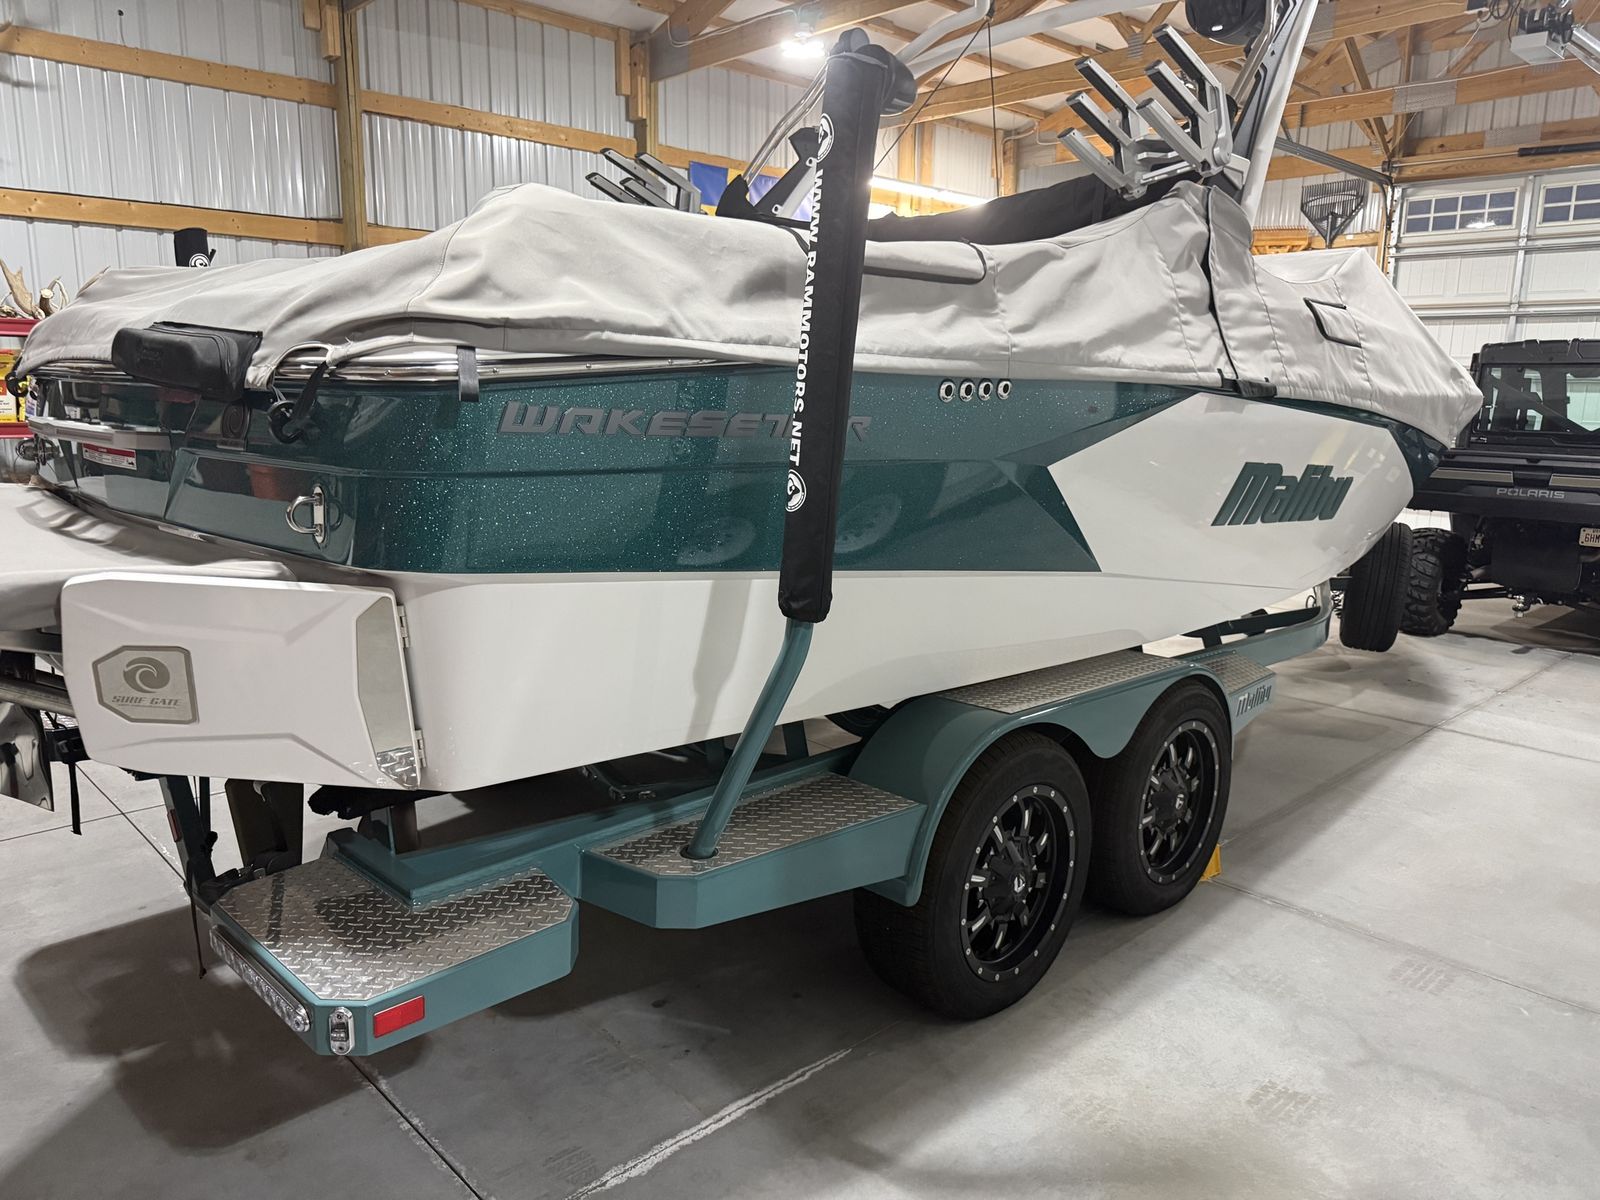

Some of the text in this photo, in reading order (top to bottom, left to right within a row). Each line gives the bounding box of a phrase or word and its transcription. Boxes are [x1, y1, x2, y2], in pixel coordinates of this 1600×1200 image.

[497, 400, 873, 441] WAKESETR
[1211, 462, 1354, 527] Malibu
[1496, 487, 1566, 499] POLARIS
[111, 695, 147, 704] SURF
[150, 697, 184, 706] GATE
[1236, 685, 1272, 717] Malibu
